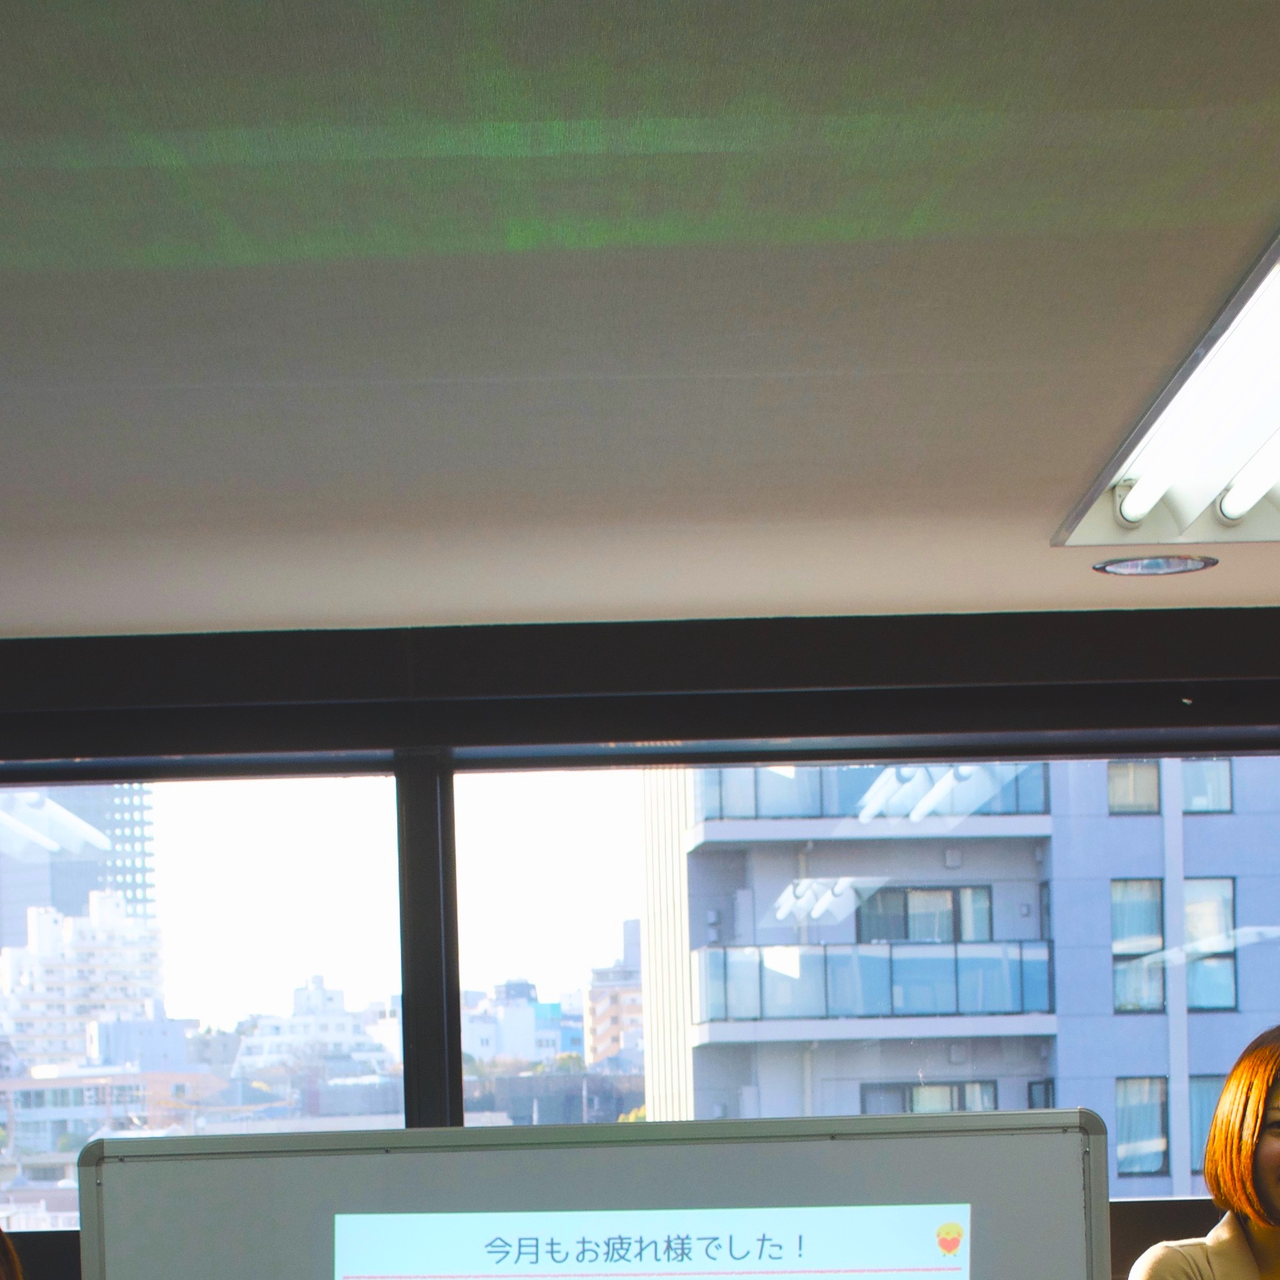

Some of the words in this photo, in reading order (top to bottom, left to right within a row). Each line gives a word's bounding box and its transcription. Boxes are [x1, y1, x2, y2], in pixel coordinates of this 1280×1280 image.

[484, 1233, 804, 1266] 今月もお疲れ様でした！
